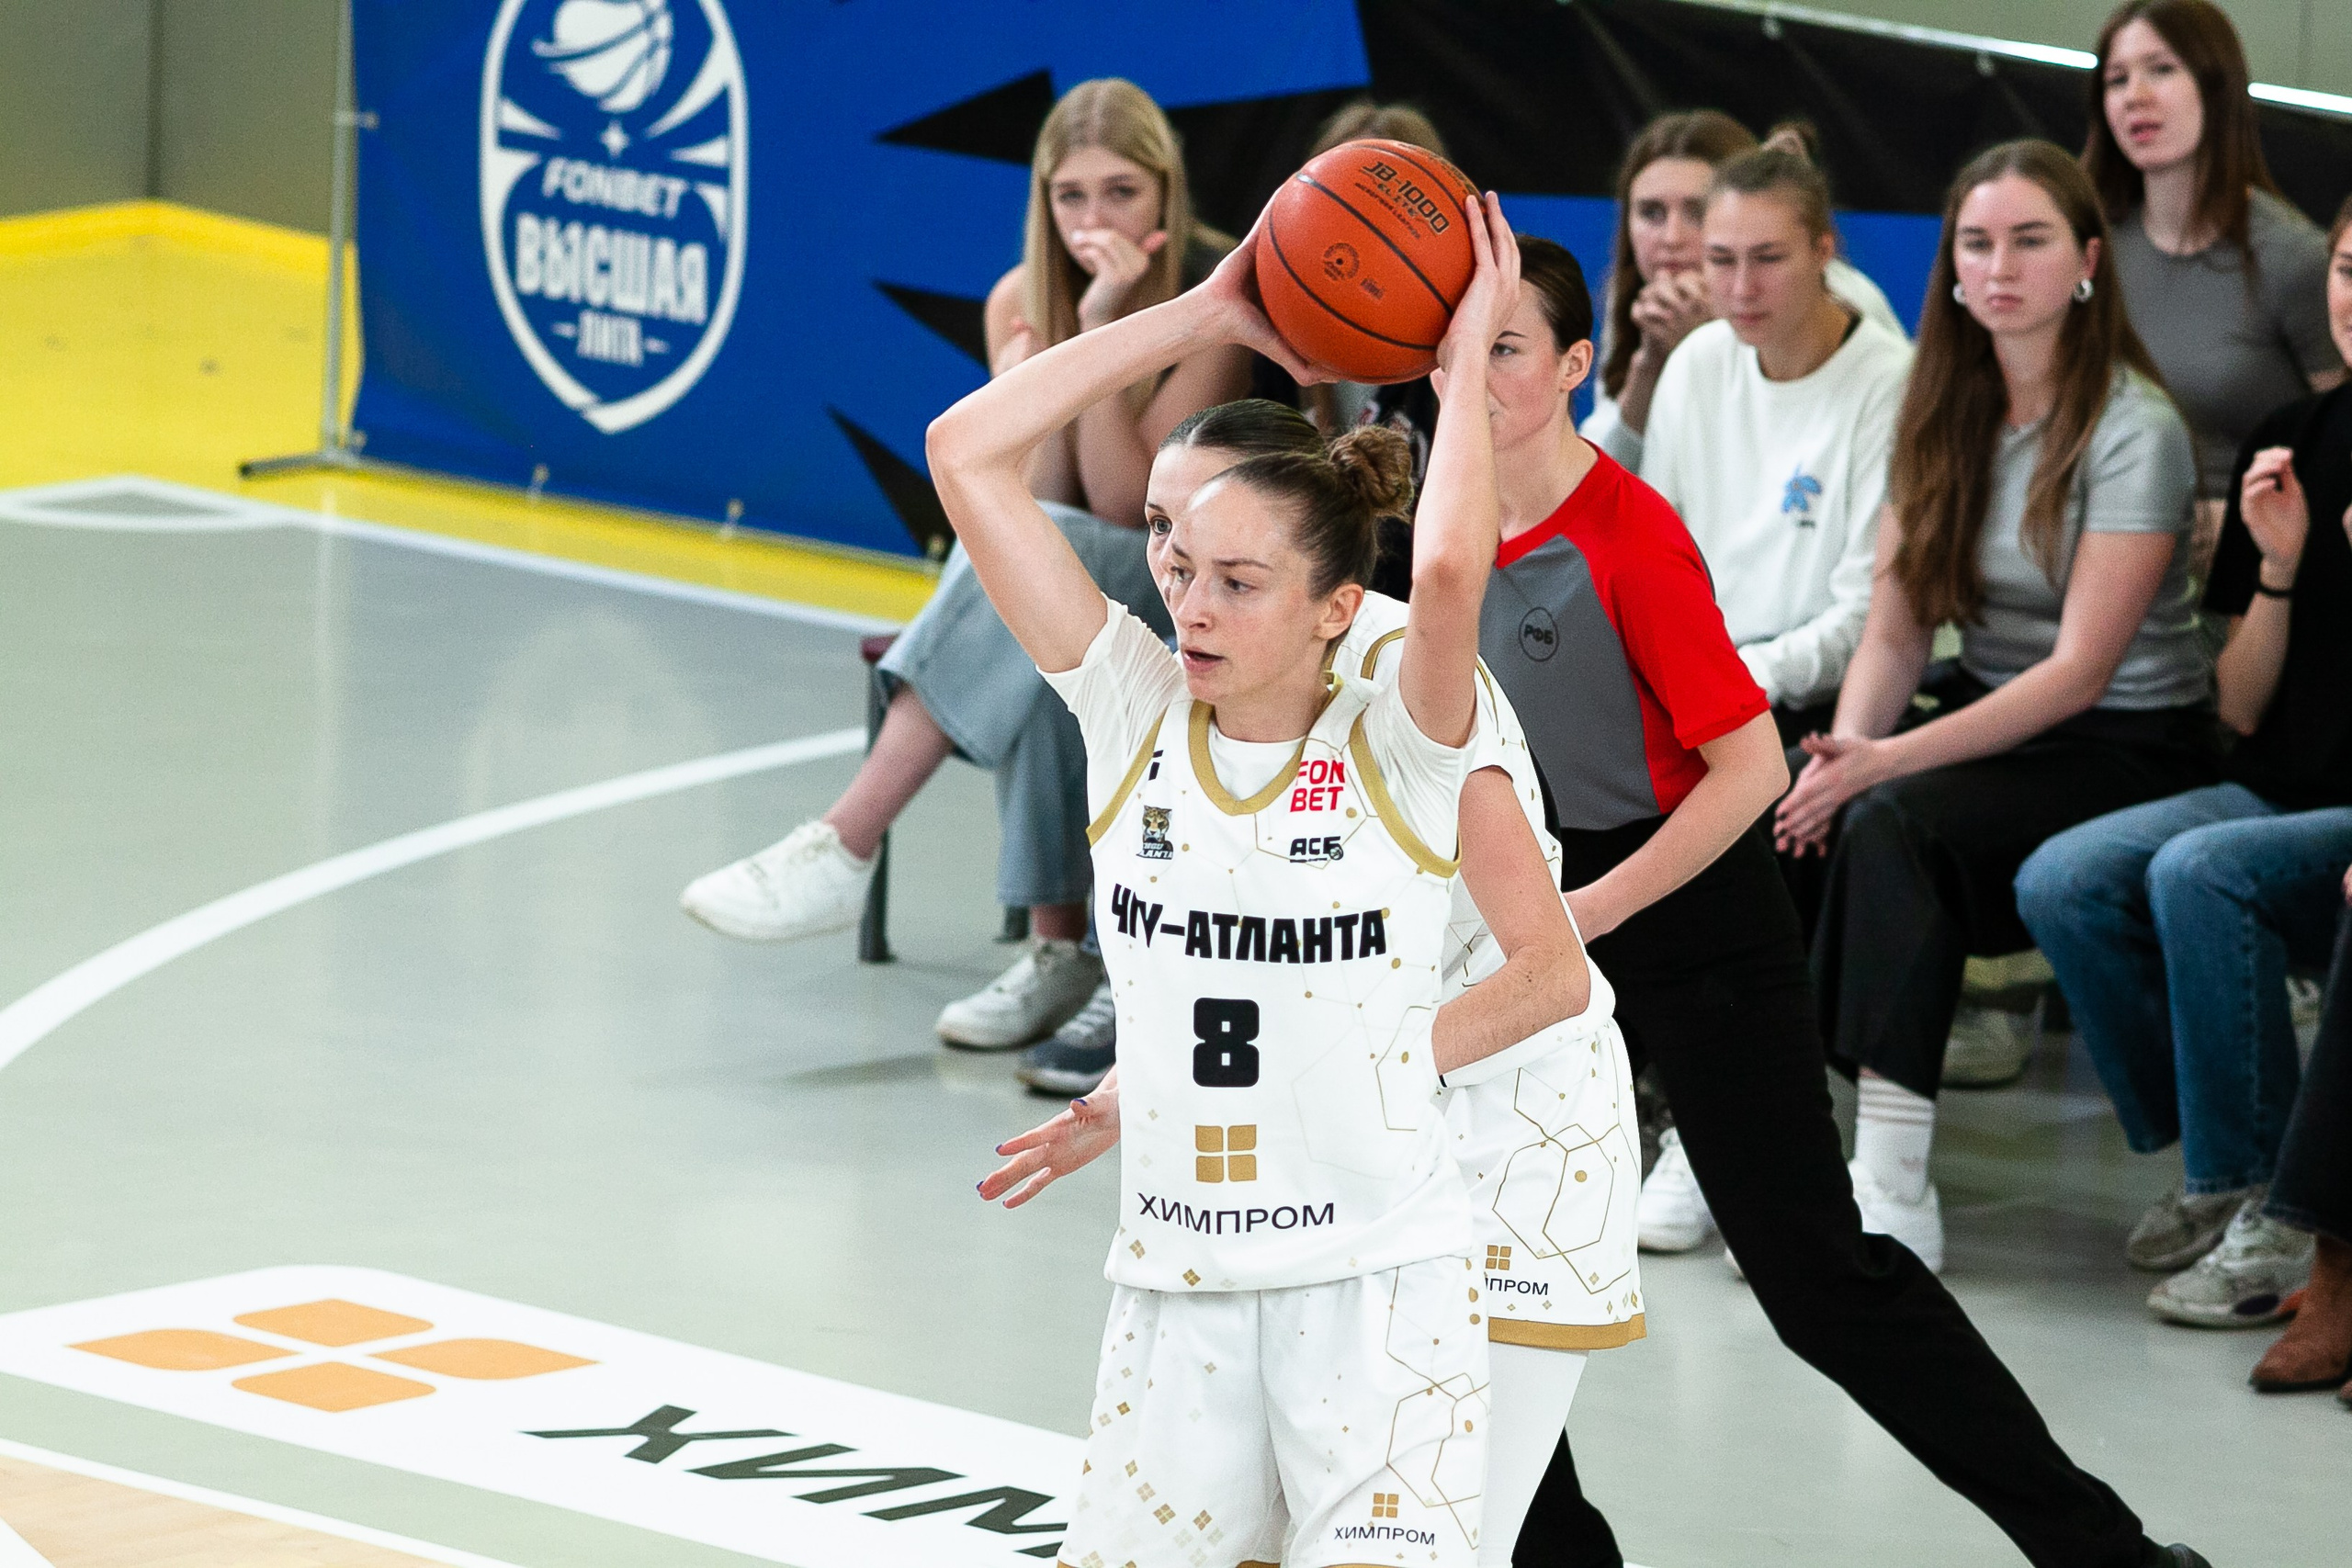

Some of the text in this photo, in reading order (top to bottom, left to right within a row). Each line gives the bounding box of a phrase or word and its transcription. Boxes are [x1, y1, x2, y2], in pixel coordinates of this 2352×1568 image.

[542, 156, 689, 219] FONBET
[1362, 161, 1450, 233] JB-1000
[515, 211, 709, 326] ВЫСШАЯ
[1524, 624, 1554, 645] РФБ
[1296, 759, 1345, 784] FON
[1290, 786, 1344, 813] BET
[1193, 997, 1260, 1088] 8
[1137, 1191, 1335, 1235] ХИМПРОМ
[1485, 1277, 1549, 1296] ПРОМ
[1334, 1526, 1436, 1546] ХИМПРОМ
